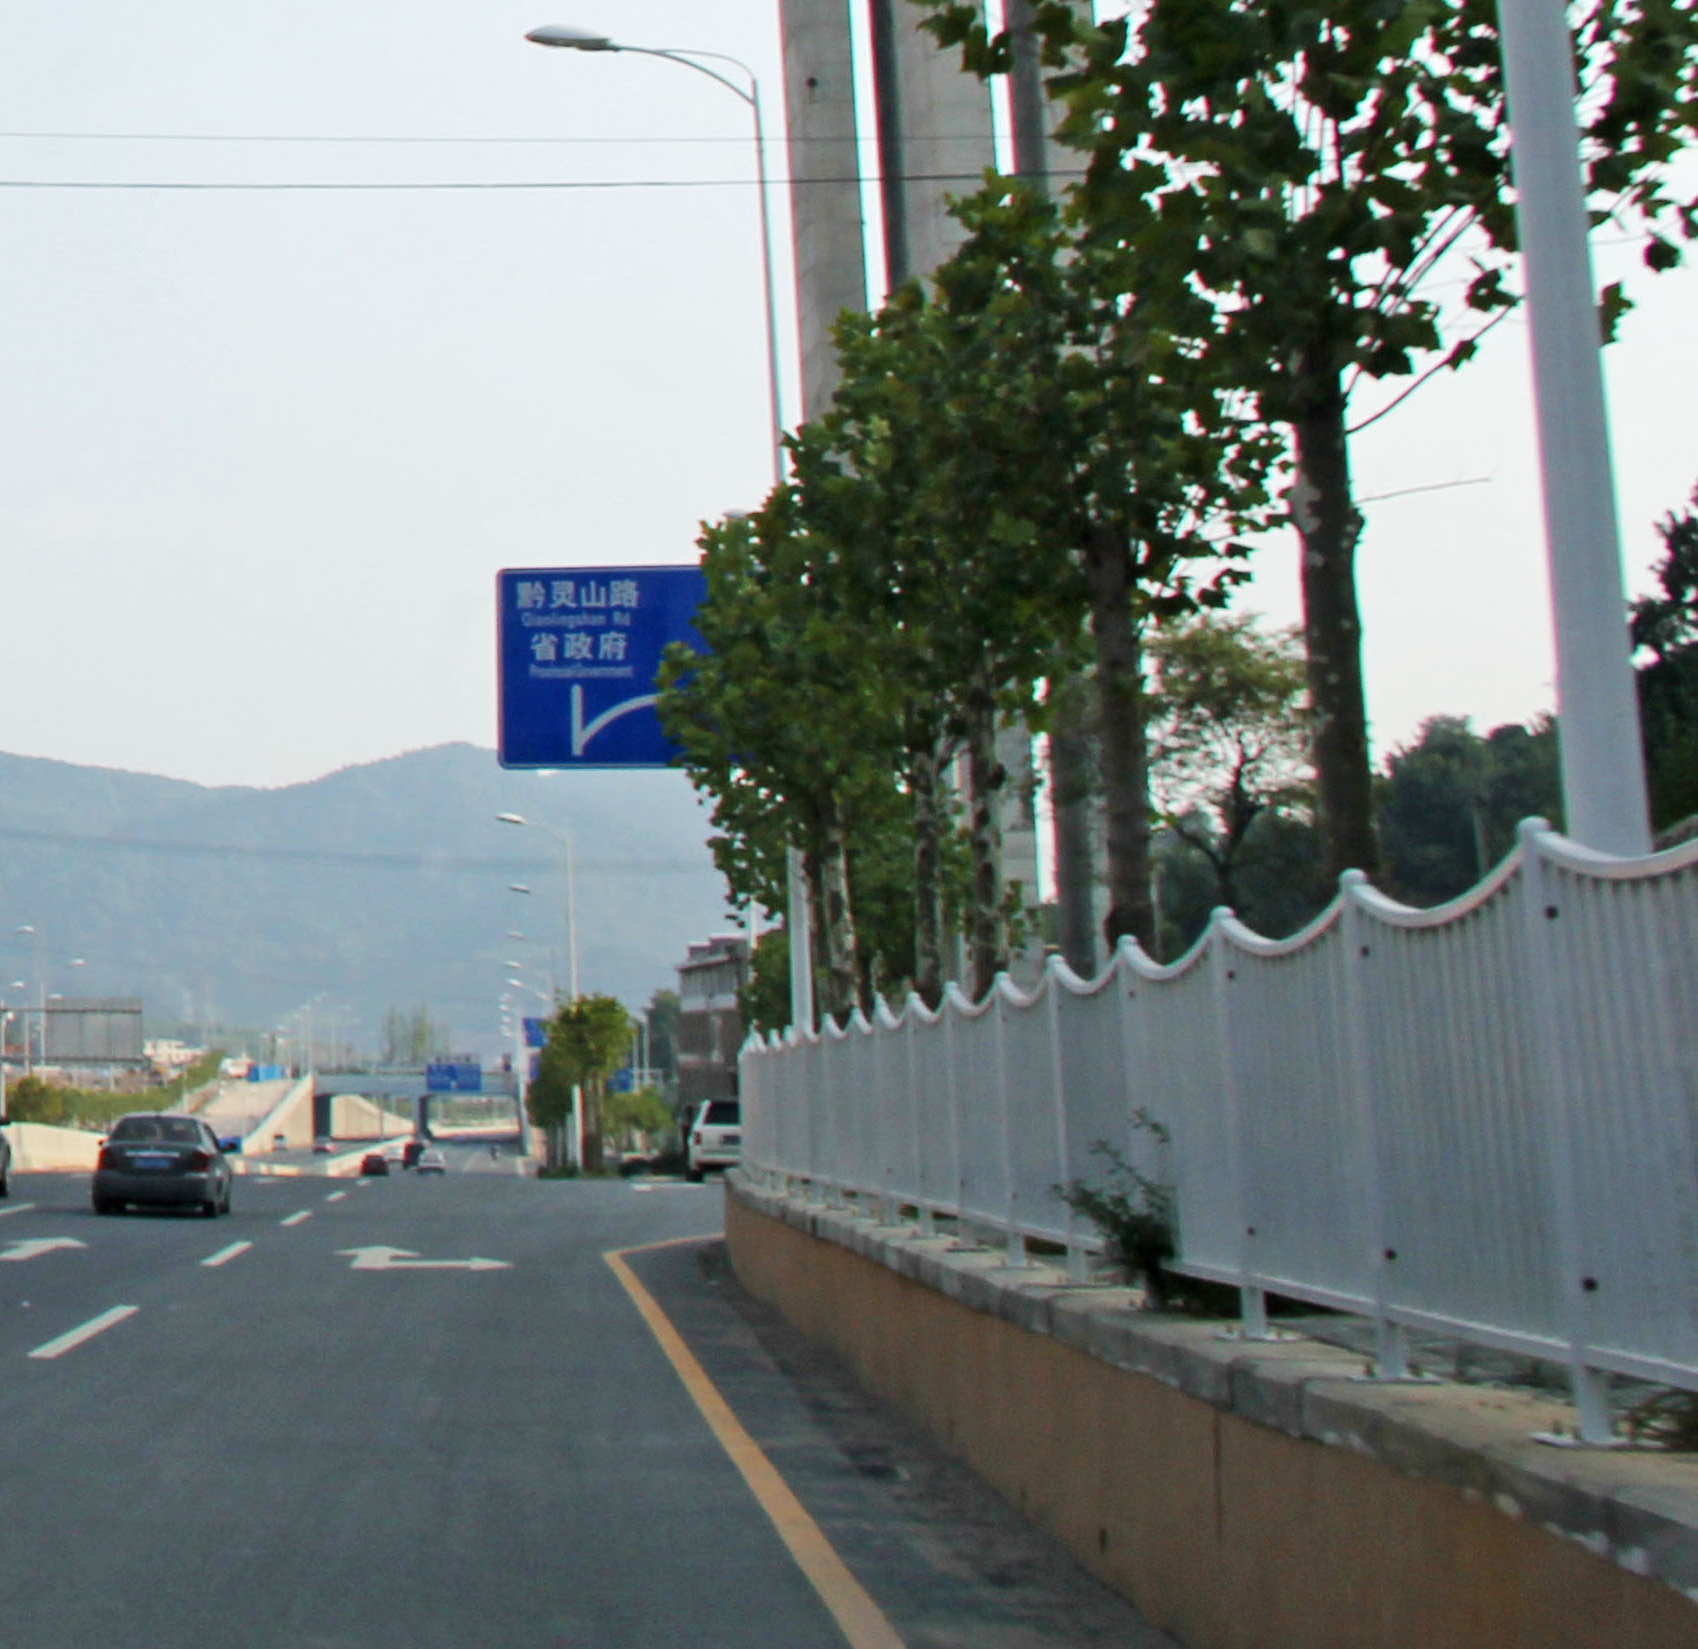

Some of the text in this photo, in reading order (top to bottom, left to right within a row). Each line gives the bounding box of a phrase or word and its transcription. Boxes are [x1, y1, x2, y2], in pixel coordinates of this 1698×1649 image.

[516, 580, 639, 608] 黔灵山路
[530, 631, 627, 661] 省政府
